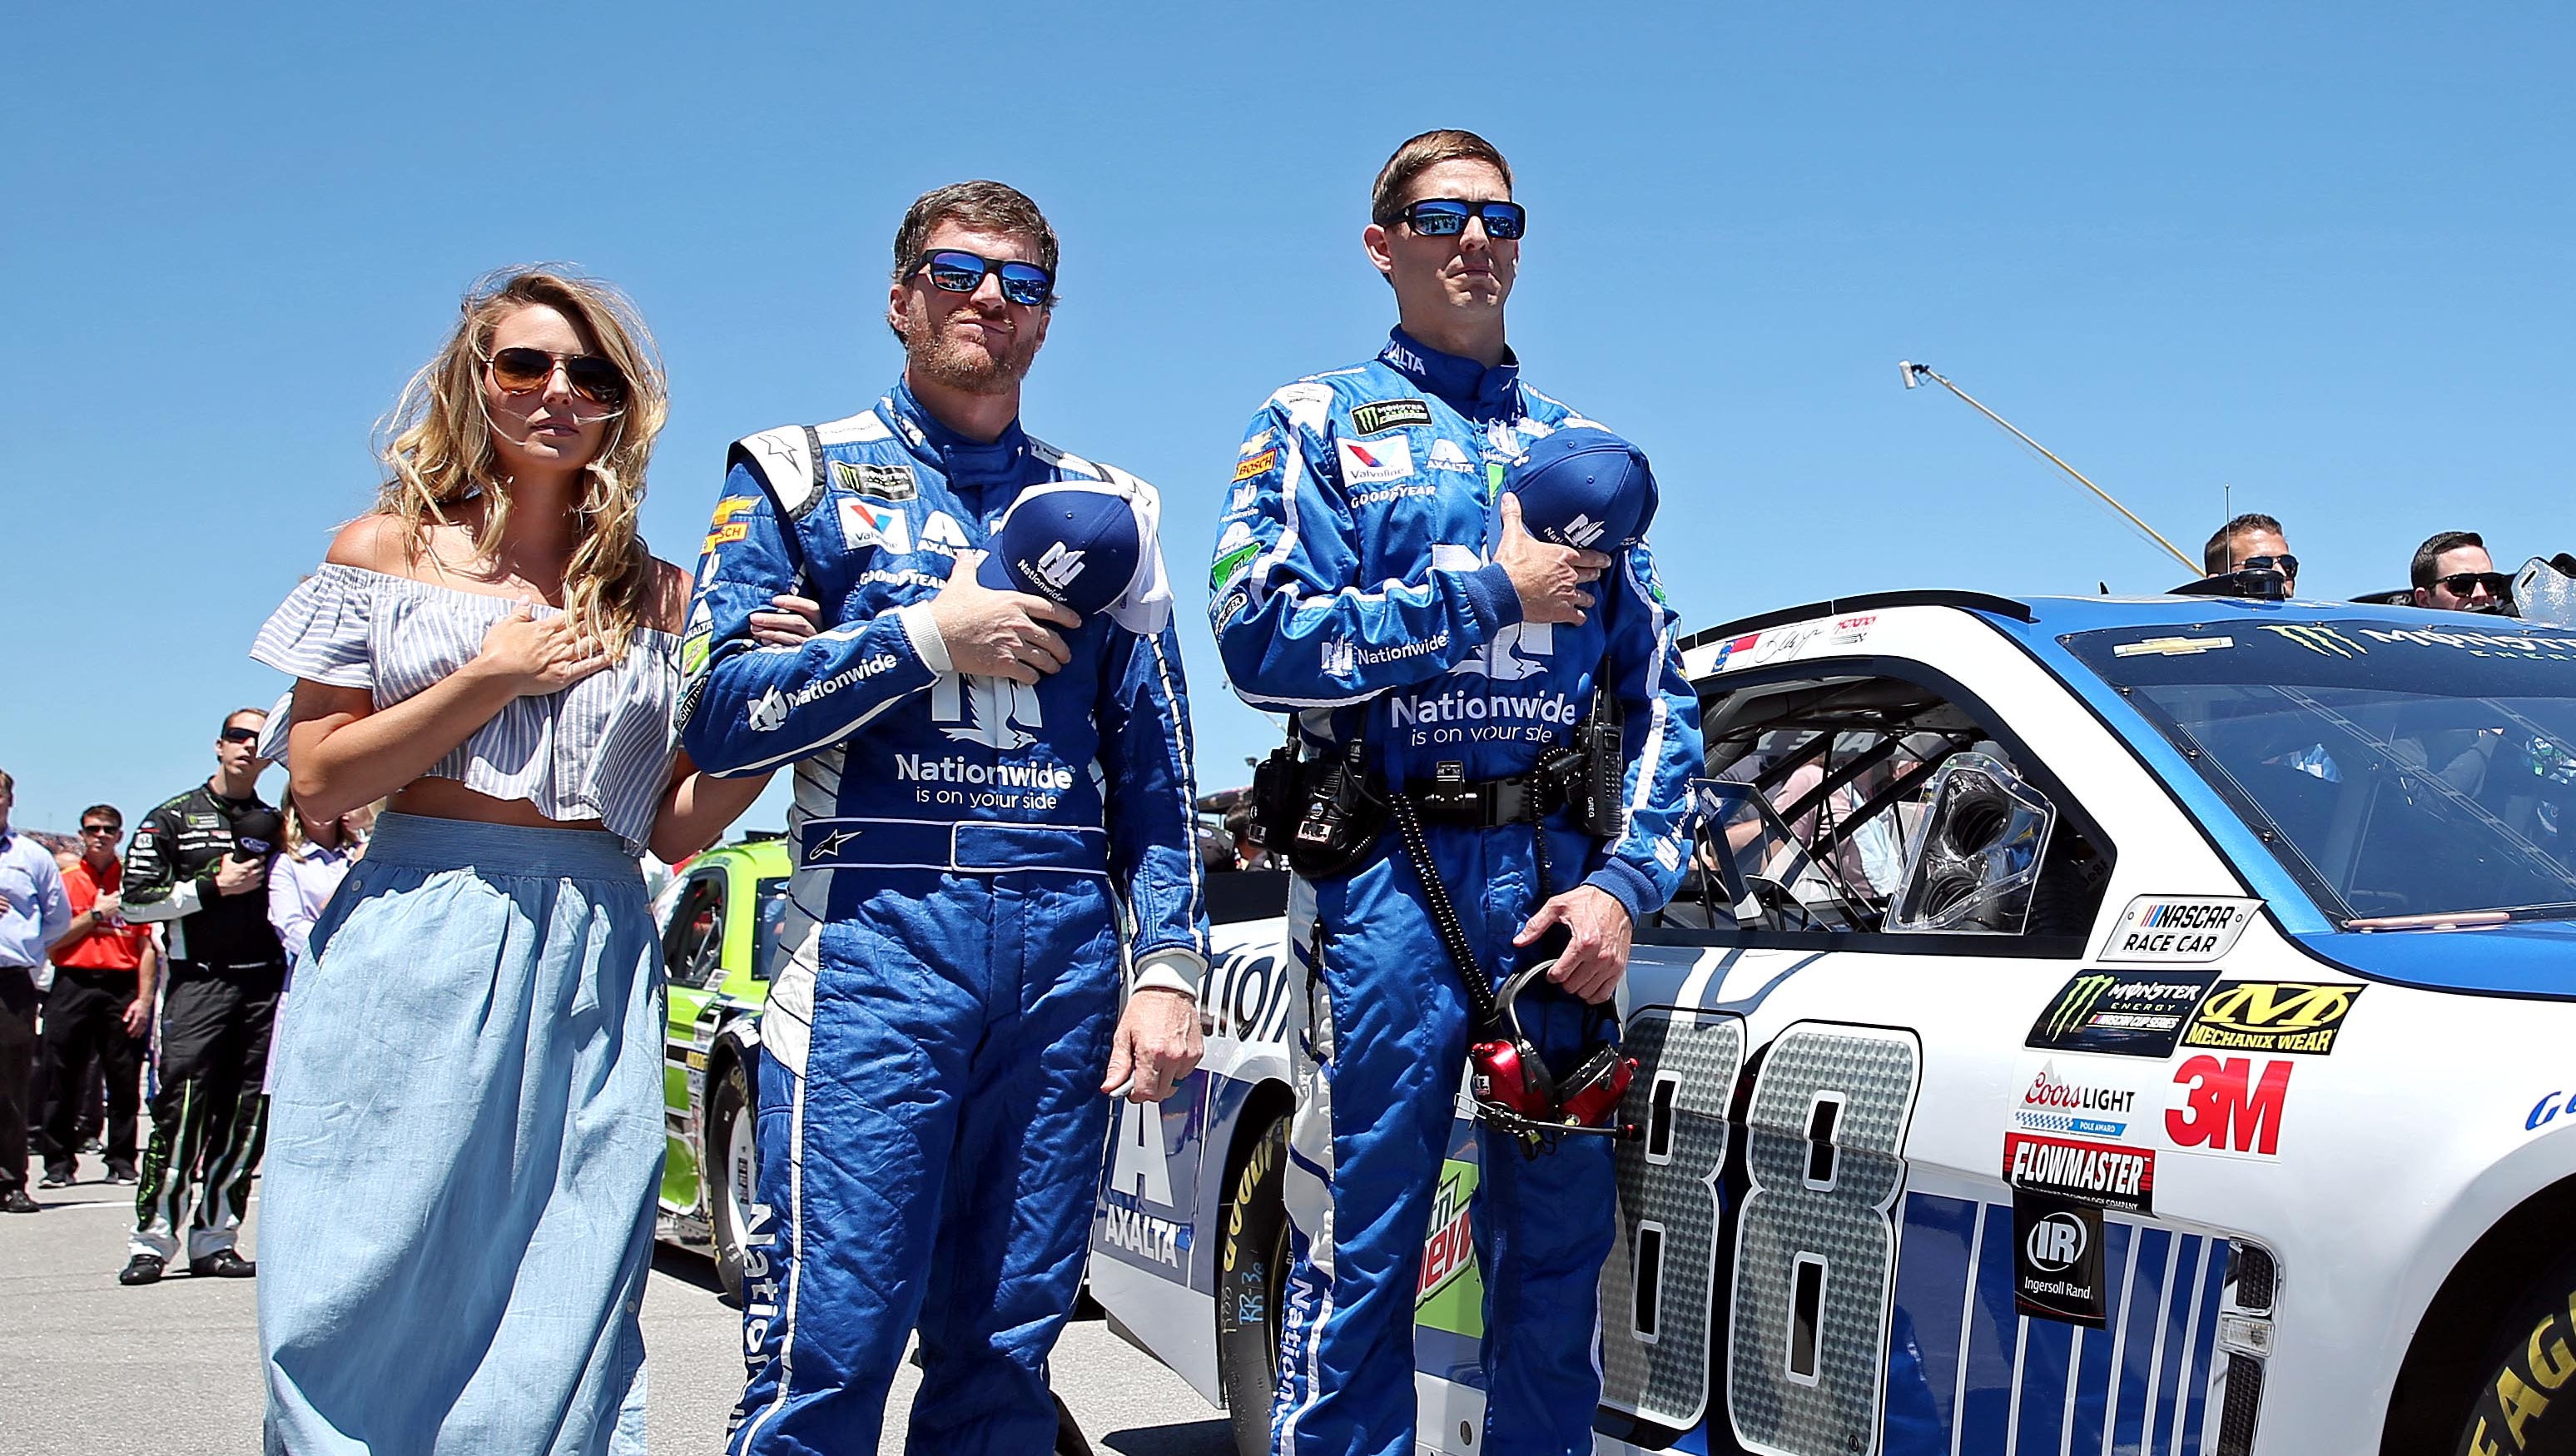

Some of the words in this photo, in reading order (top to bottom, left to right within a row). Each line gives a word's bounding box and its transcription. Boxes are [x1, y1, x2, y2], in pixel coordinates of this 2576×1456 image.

[1238, 455, 1272, 475] BOSCH
[1426, 462, 1475, 474] AXALTA
[1351, 484, 1437, 509] GOODYEAR
[1017, 559, 1068, 603] Nationwide
[1357, 633, 1448, 665] Nationwide
[786, 653, 897, 710] Nationwide
[1391, 690, 1576, 728] Nationwide
[1412, 729, 1427, 747] is
[1434, 728, 1462, 743] on
[1470, 725, 1521, 743] your
[895, 754, 1073, 790] Nationwide
[916, 786, 930, 803] is
[936, 790, 963, 803] on
[970, 792, 1019, 808] your
[1022, 792, 1057, 809] side
[2156, 904, 2236, 929] NASCAR
[2122, 932, 2176, 952] RACE
[2176, 934, 2218, 952] CAR
[2111, 1001, 2176, 1011] ENERGY
[2186, 1022, 2272, 1049] MECHANIX
[2276, 1029, 2333, 1051] WEAR
[2025, 1072, 2081, 1108] Coors
[2082, 1087, 2136, 1113] LIGHT
[2165, 1055, 2294, 1155] 3M
[2079, 1121, 2095, 1131] POLE
[2094, 1122, 2116, 1133] AWARD
[2011, 1140, 2146, 1196] FLOWMASTER
[1104, 1204, 1179, 1270] AXALTA
[2036, 1220, 2077, 1265] IR
[2024, 1275, 2065, 1295] Ingersoll
[2065, 1285, 2092, 1299] Rand
